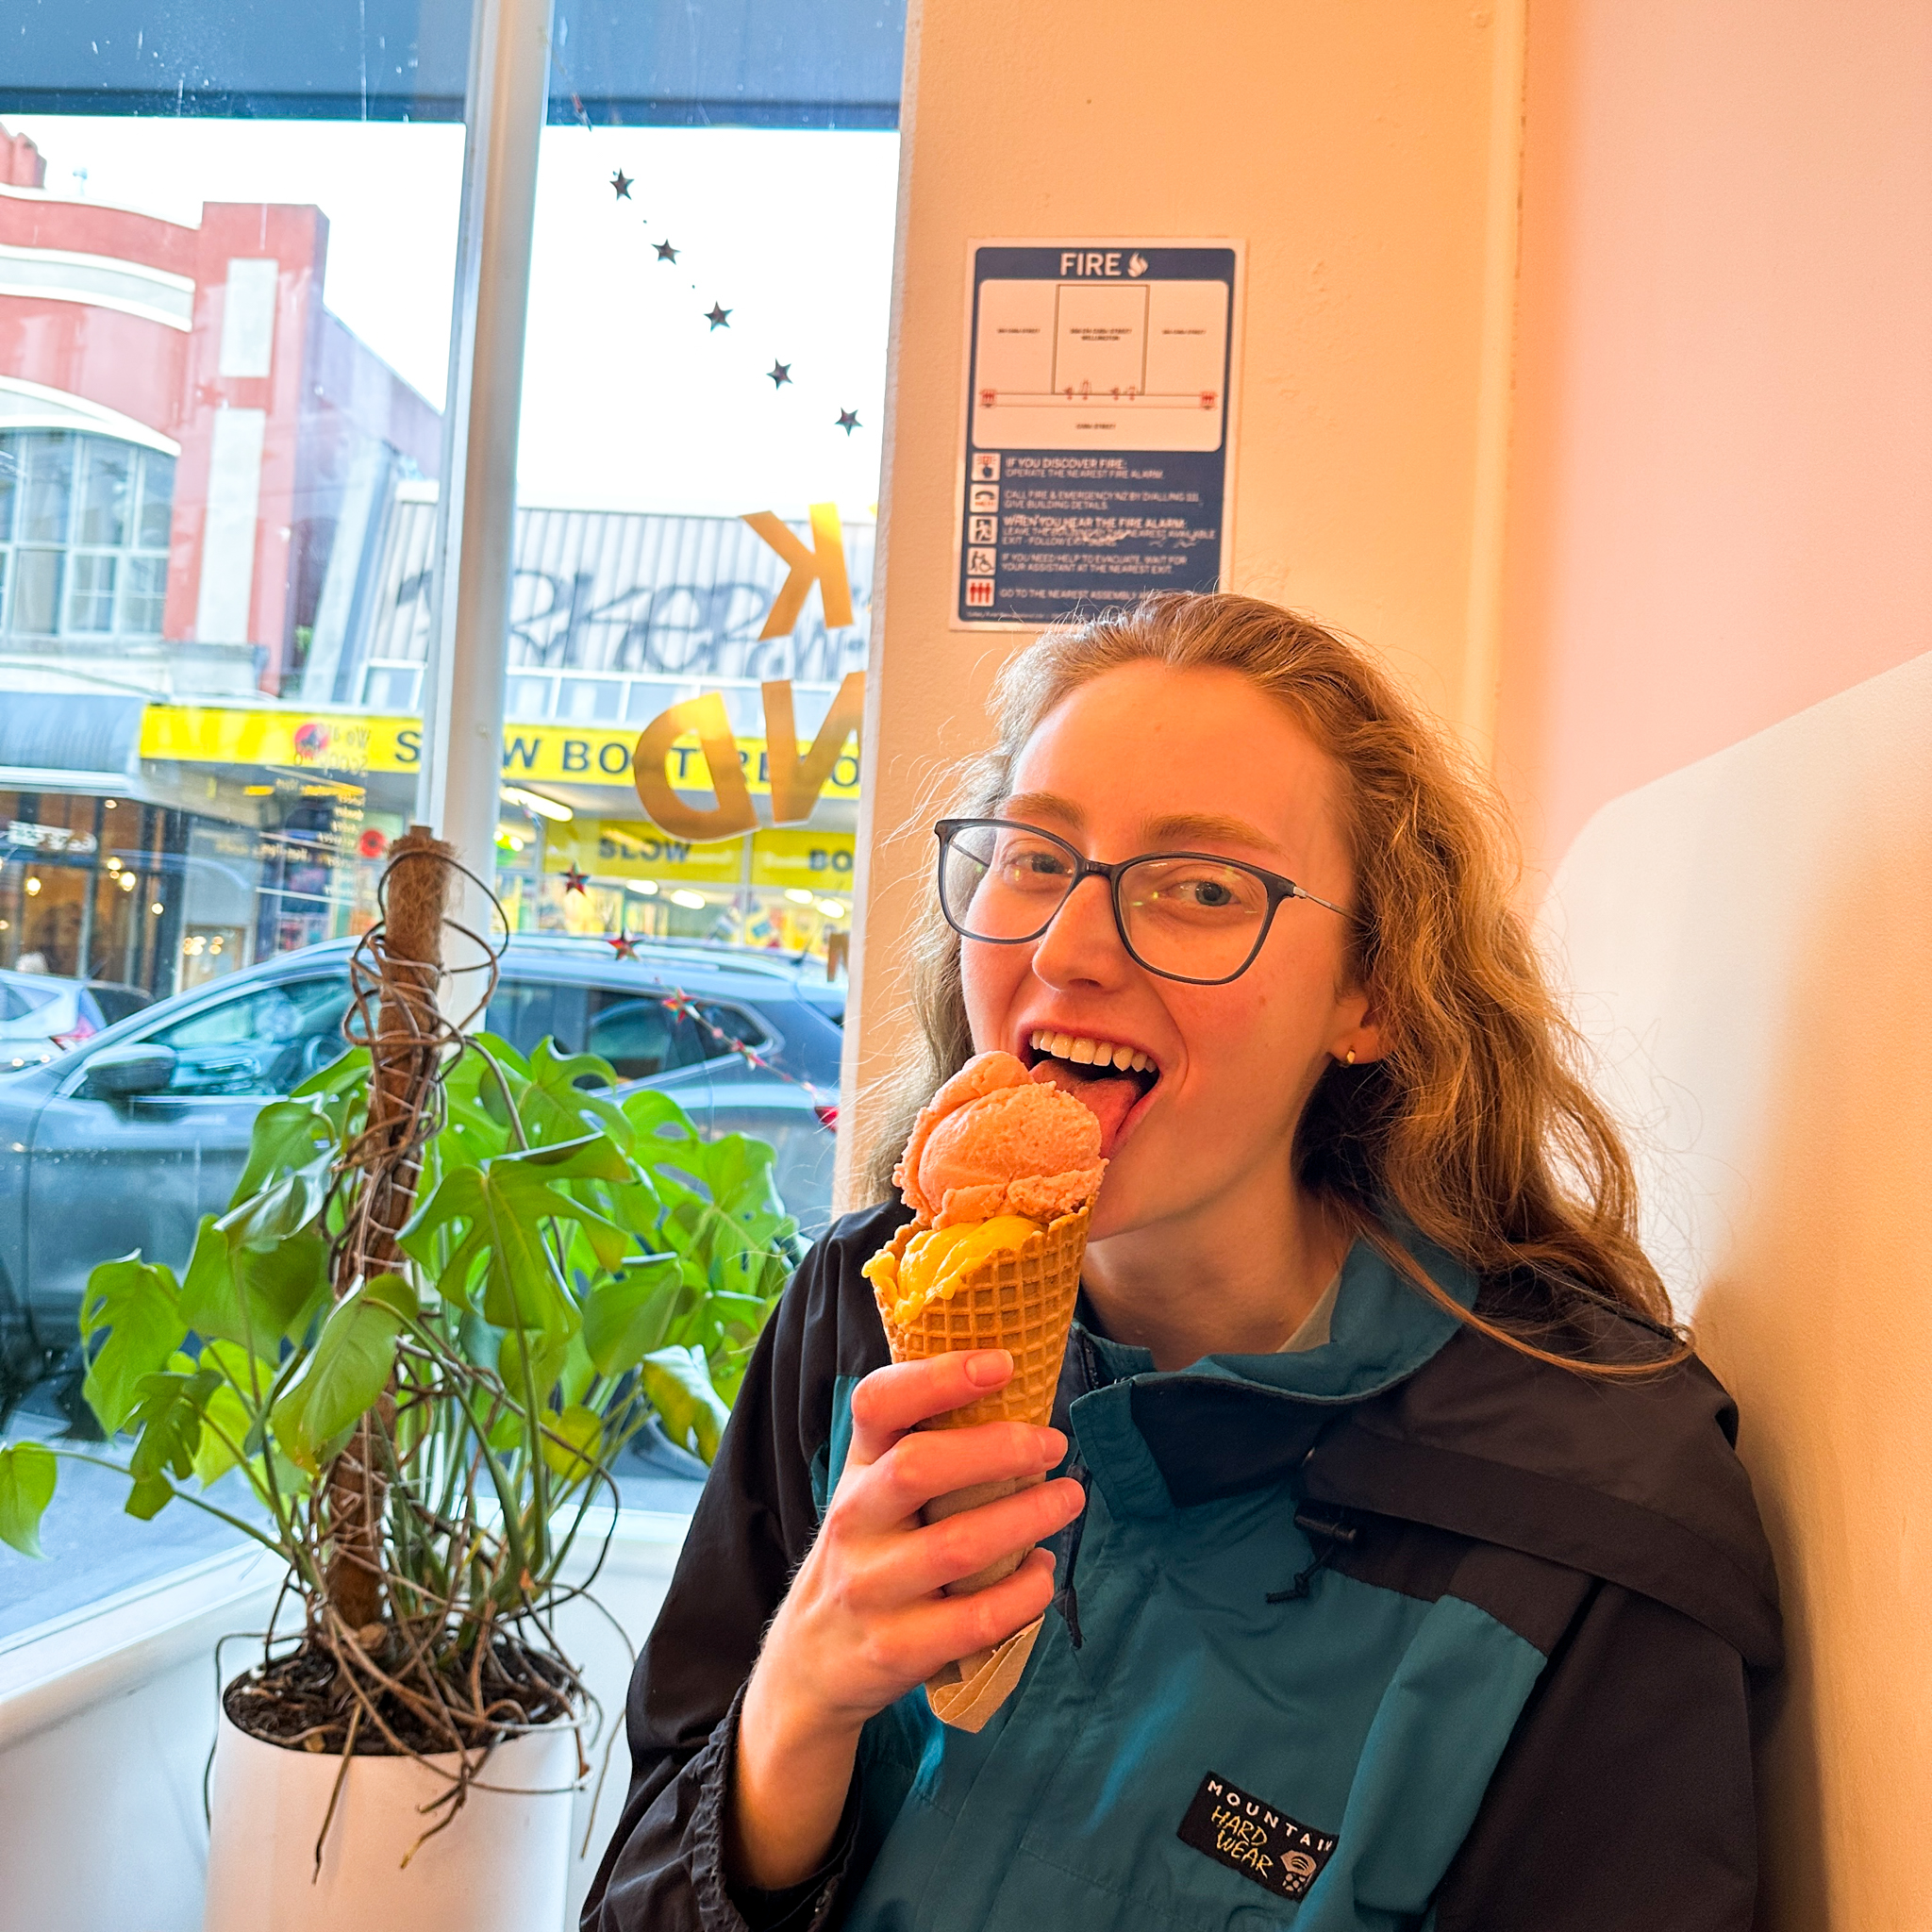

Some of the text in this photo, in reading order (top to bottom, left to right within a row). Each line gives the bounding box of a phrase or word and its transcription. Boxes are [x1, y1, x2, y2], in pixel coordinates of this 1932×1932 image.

[1059, 253, 1123, 276] FIRE
[1006, 457, 1016, 469] IF
[1019, 457, 1041, 469] YOU
[1041, 457, 1098, 470] DISCOVER
[1048, 469, 1065, 478] THE
[1067, 469, 1108, 479] NEAREST
[1108, 469, 1128, 479] FIRE
[1004, 490, 1026, 500] CALL
[1027, 490, 1047, 500] FIRE
[1003, 515, 1038, 526] WHEN
[1039, 516, 1062, 527] YOU
[1062, 516, 1094, 527] HEAR
[1095, 517, 1116, 528] THE
[1118, 517, 1142, 528] FIRE
[1010, 553, 1030, 563] YOU
[1001, 562, 1026, 572] YOUR
[1090, 564, 1107, 574] THE
[999, 588, 1015, 598] GO
[1015, 588, 1028, 599] TO
[1028, 589, 1046, 599] THE
[1047, 590, 1090, 600] NEAREST
[561, 740, 697, 780] BOT
[598, 836, 694, 864] SLOW
[1210, 1805, 1268, 1847] HARD
[1217, 1829, 1274, 1879] WEAR
